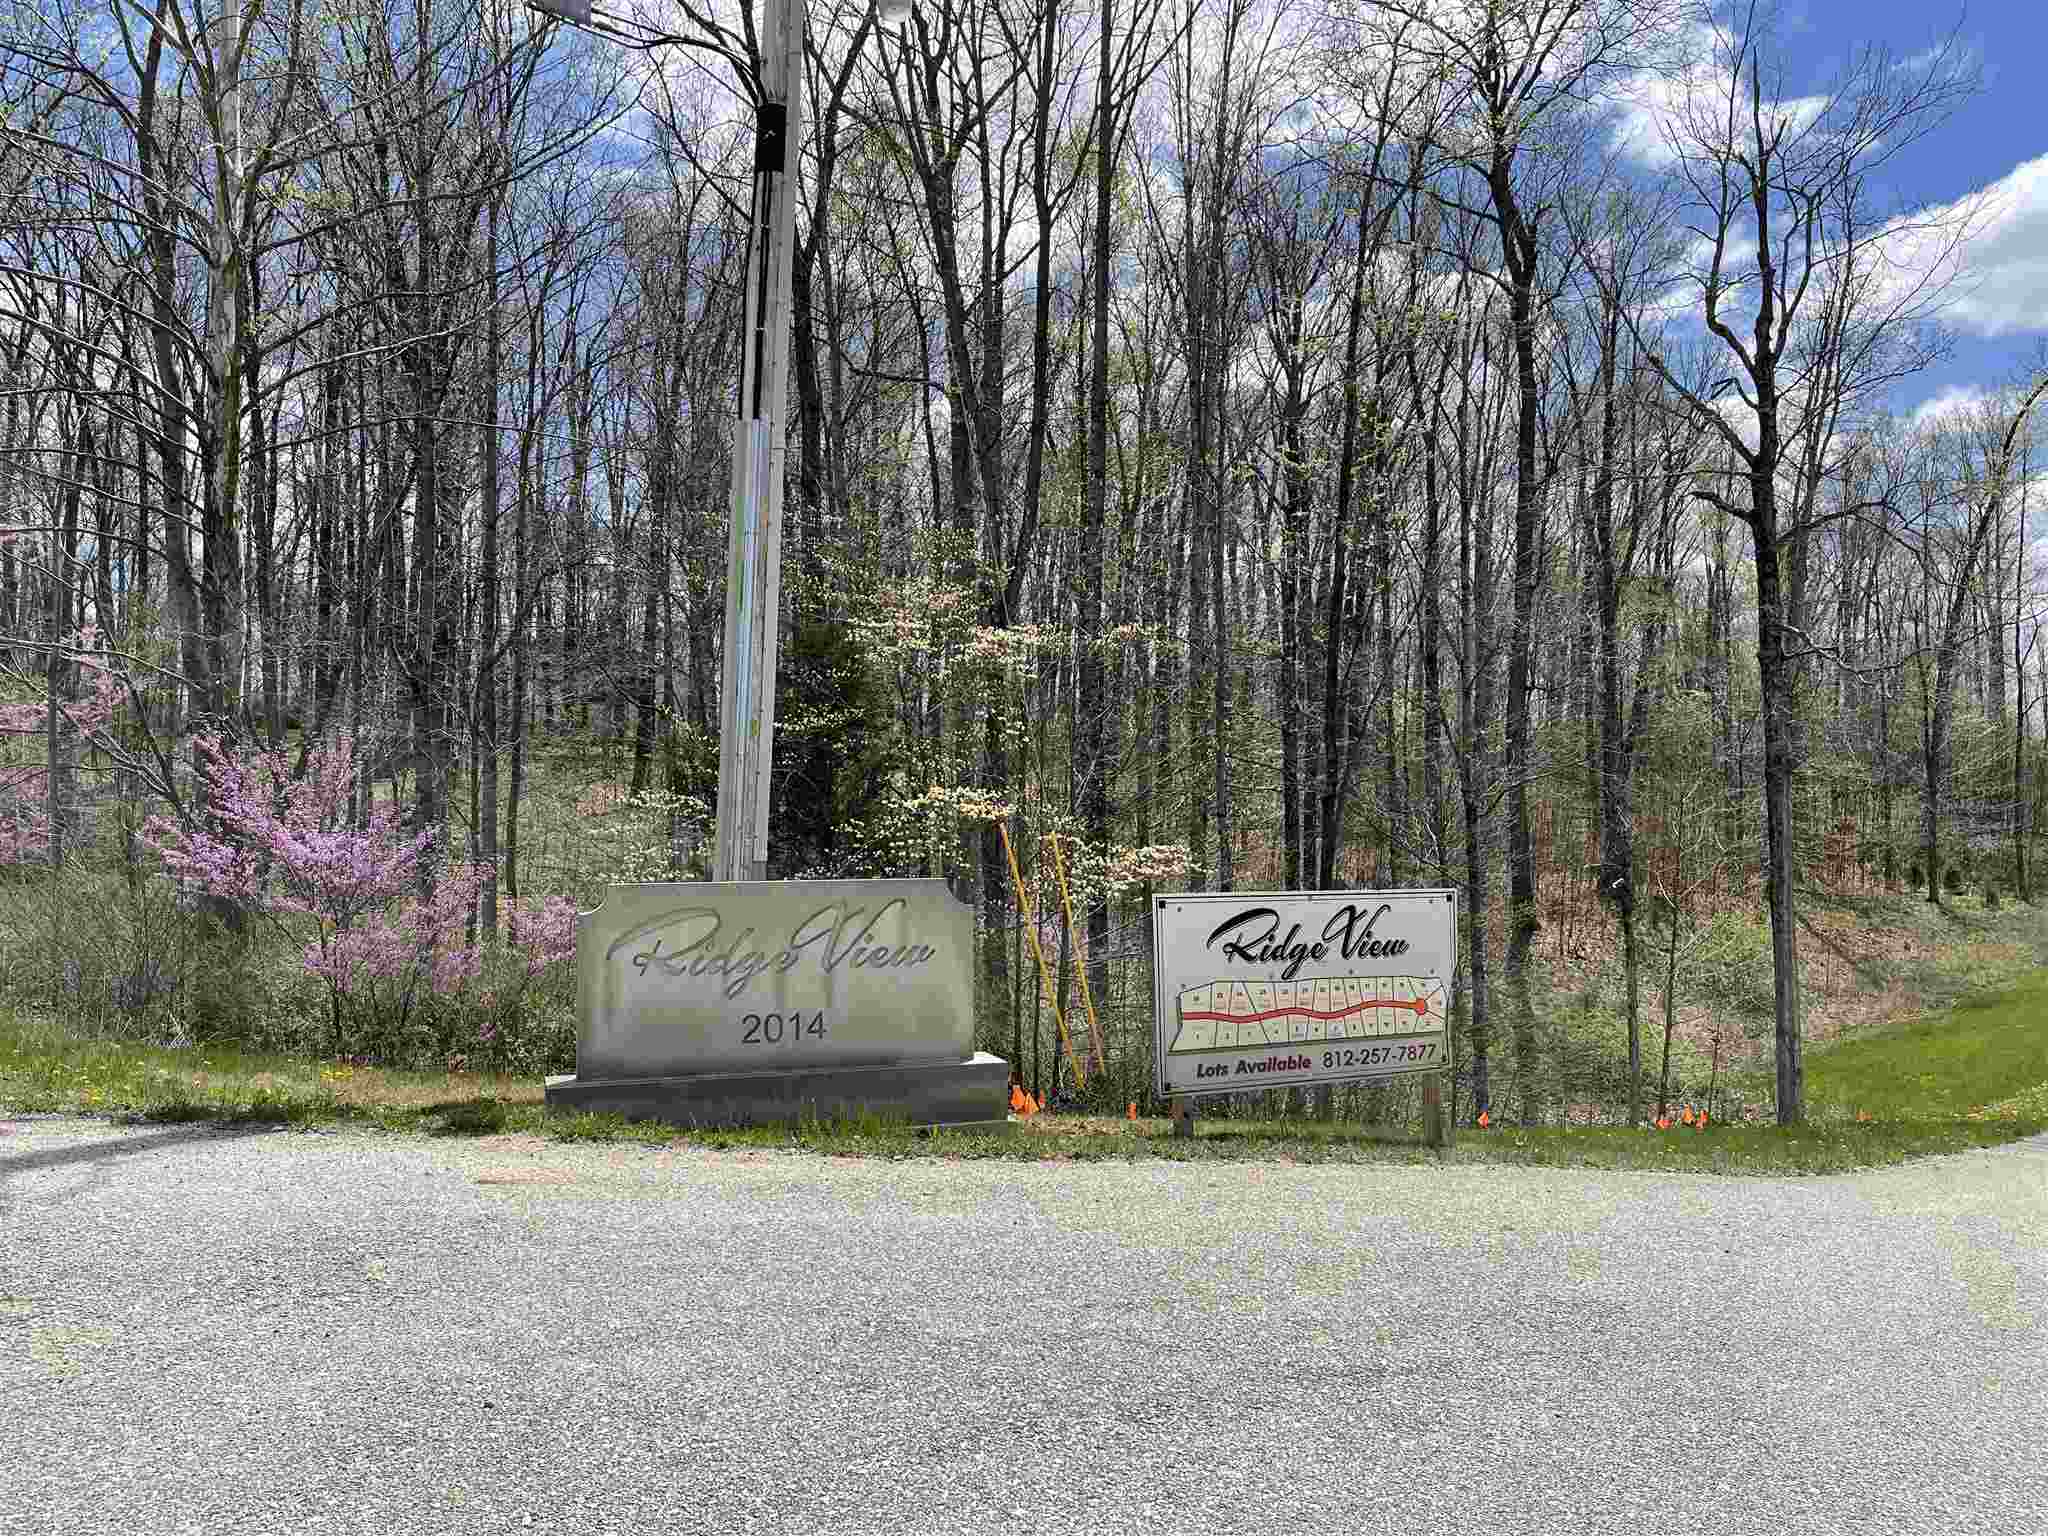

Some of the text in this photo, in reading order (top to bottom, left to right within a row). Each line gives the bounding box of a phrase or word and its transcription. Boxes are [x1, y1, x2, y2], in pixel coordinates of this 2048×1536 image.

[606, 898, 937, 1000] Ridge View
[1206, 903, 1410, 980] Ridge View
[741, 1010, 827, 1044] 2014
[1196, 1043, 1437, 1079] Lots Available 812-257-7877
